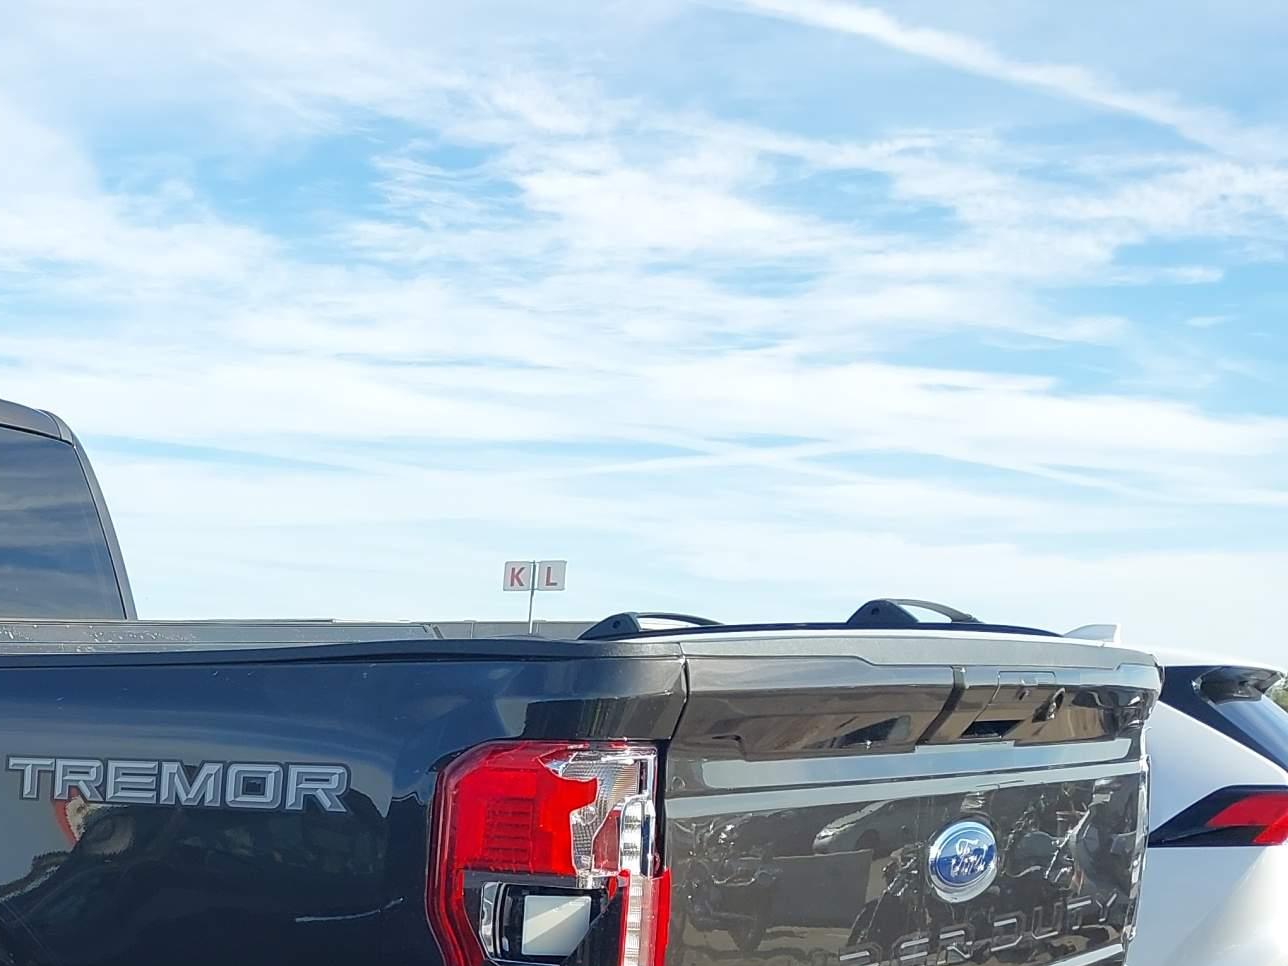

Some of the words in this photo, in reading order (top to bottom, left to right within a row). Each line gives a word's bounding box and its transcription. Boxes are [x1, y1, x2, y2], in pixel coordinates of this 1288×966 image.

[510, 567, 525, 587] K
[545, 566, 558, 587] L
[7, 755, 354, 814] TREMOR
[988, 892, 1120, 954] DUTY
